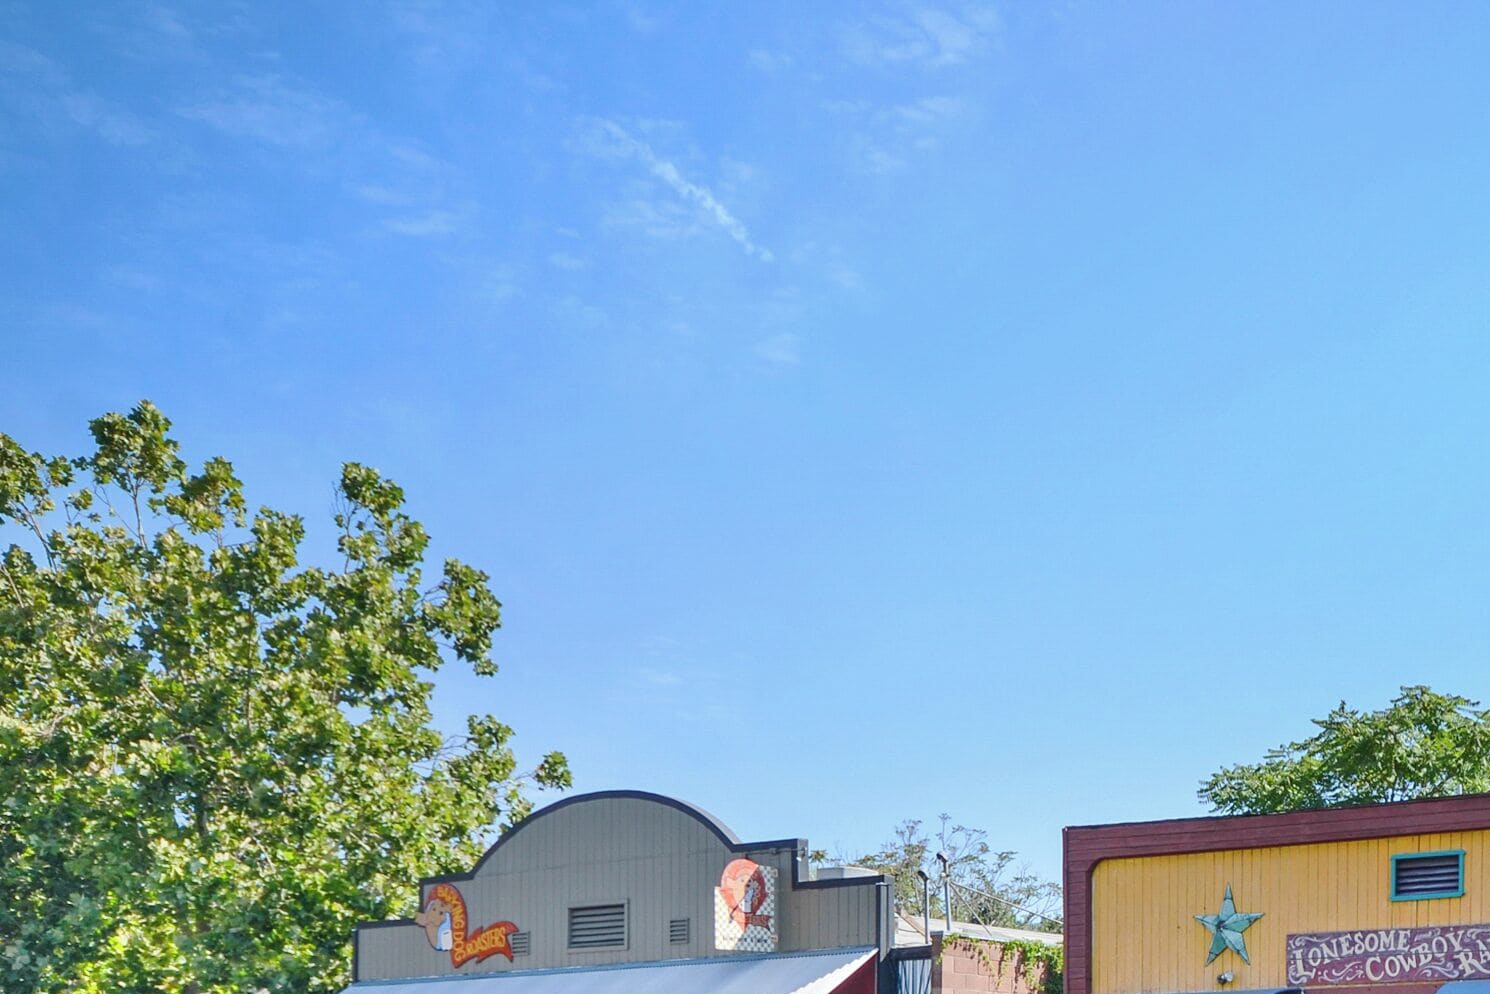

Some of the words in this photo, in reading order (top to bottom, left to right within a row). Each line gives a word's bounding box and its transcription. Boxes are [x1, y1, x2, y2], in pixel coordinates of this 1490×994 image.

[436, 885, 466, 930] BARKING
[453, 931, 466, 962] DOG
[466, 925, 507, 954] ROASTERS
[1290, 928, 1412, 981] LONESOME
[1365, 926, 1465, 982] COWBOY
